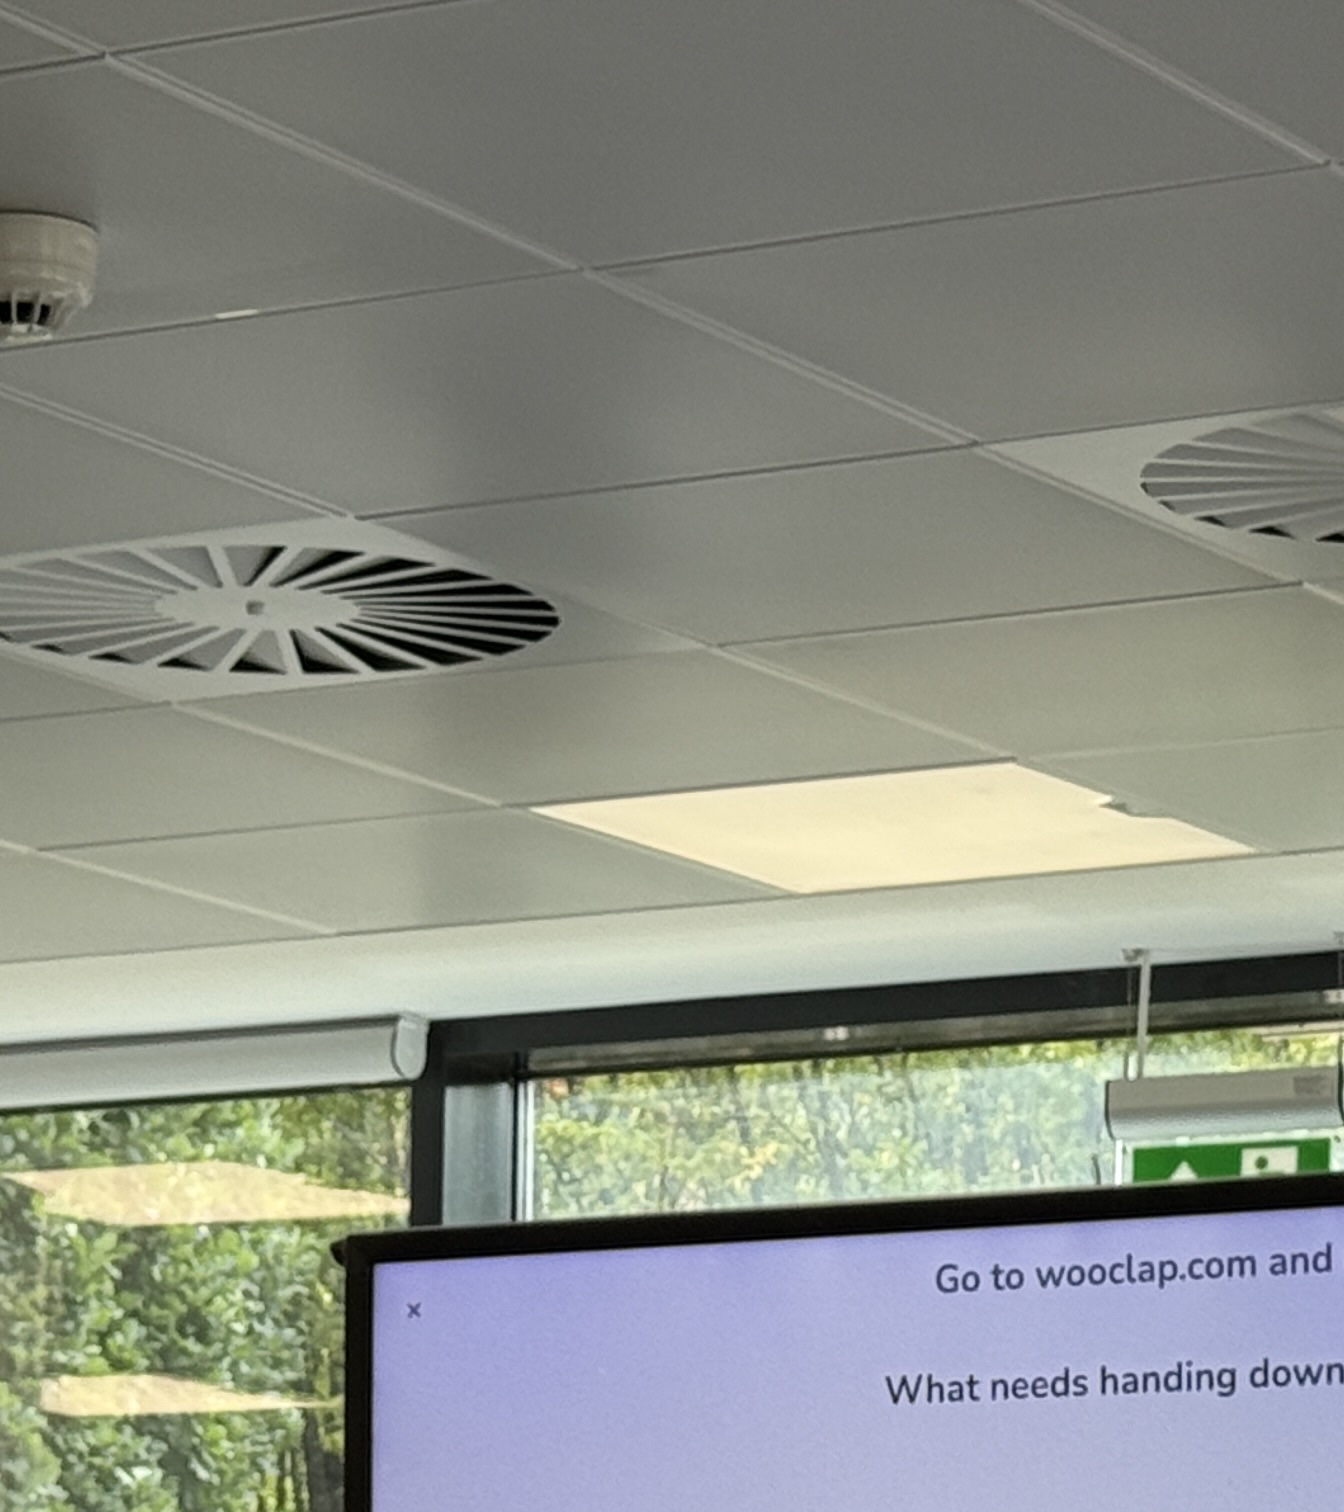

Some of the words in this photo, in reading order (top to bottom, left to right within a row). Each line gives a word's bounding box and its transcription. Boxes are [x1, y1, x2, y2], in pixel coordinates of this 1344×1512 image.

[935, 1263, 981, 1294] Go
[990, 1263, 1025, 1291] to
[1035, 1252, 1257, 1290] wooclap.com
[1268, 1241, 1333, 1277] and
[885, 1373, 981, 1405] What
[991, 1366, 1089, 1401] needs
[1100, 1360, 1237, 1398] handing
